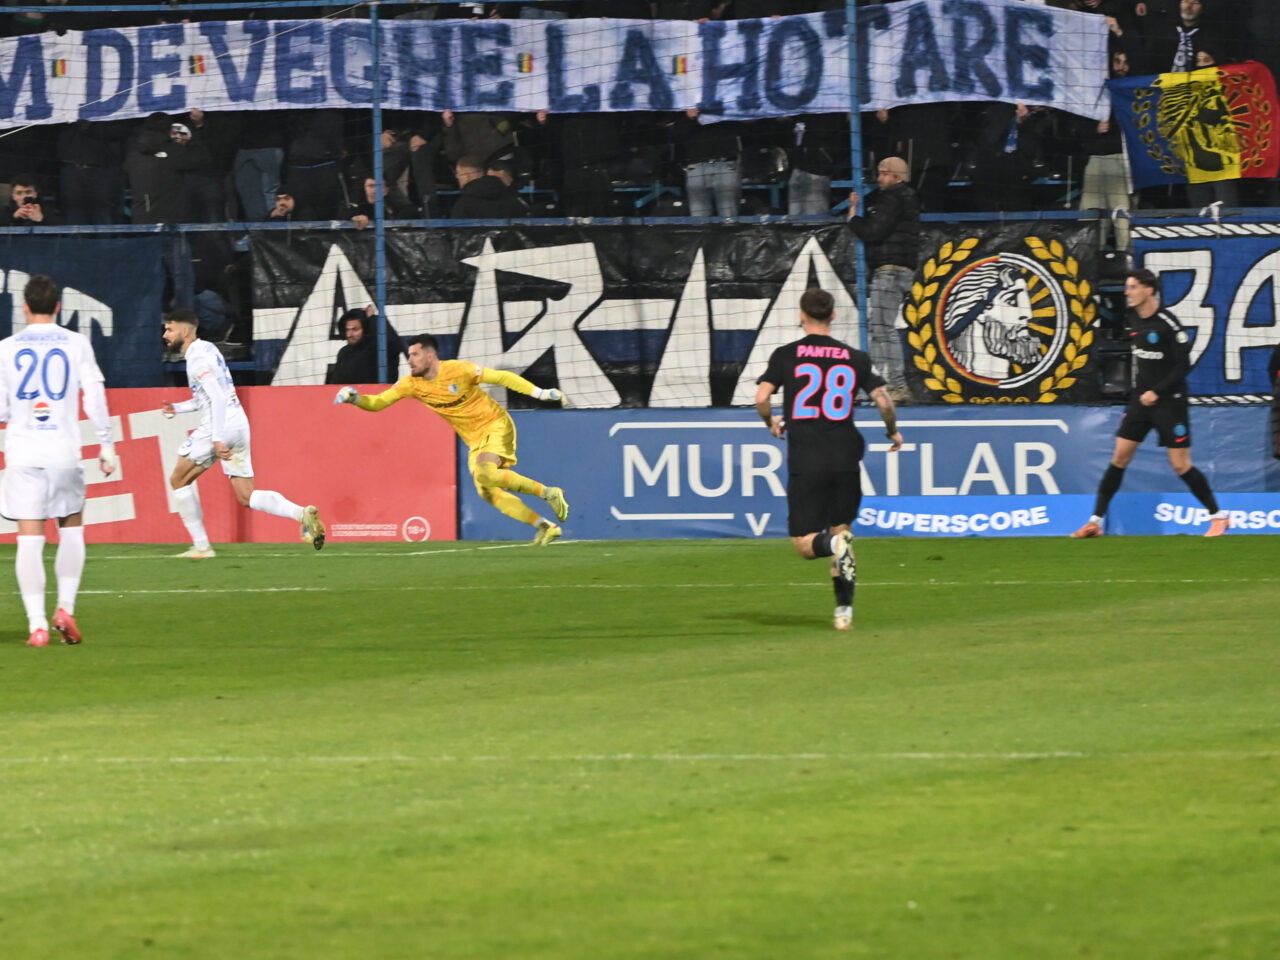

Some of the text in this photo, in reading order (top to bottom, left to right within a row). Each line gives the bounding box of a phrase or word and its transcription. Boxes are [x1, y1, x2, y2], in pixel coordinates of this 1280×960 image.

[78, 23, 188, 120] DE
[199, 19, 516, 110] VEGHE
[545, 23, 674, 111] LA
[14, 348, 70, 401] 20
[796, 344, 851, 360] PANTEA
[792, 362, 857, 421] 28
[624, 442, 1061, 497] MURTLAR
[856, 505, 1050, 533] SUPERSCORE
[1153, 502, 1280, 529] SUPRSC
